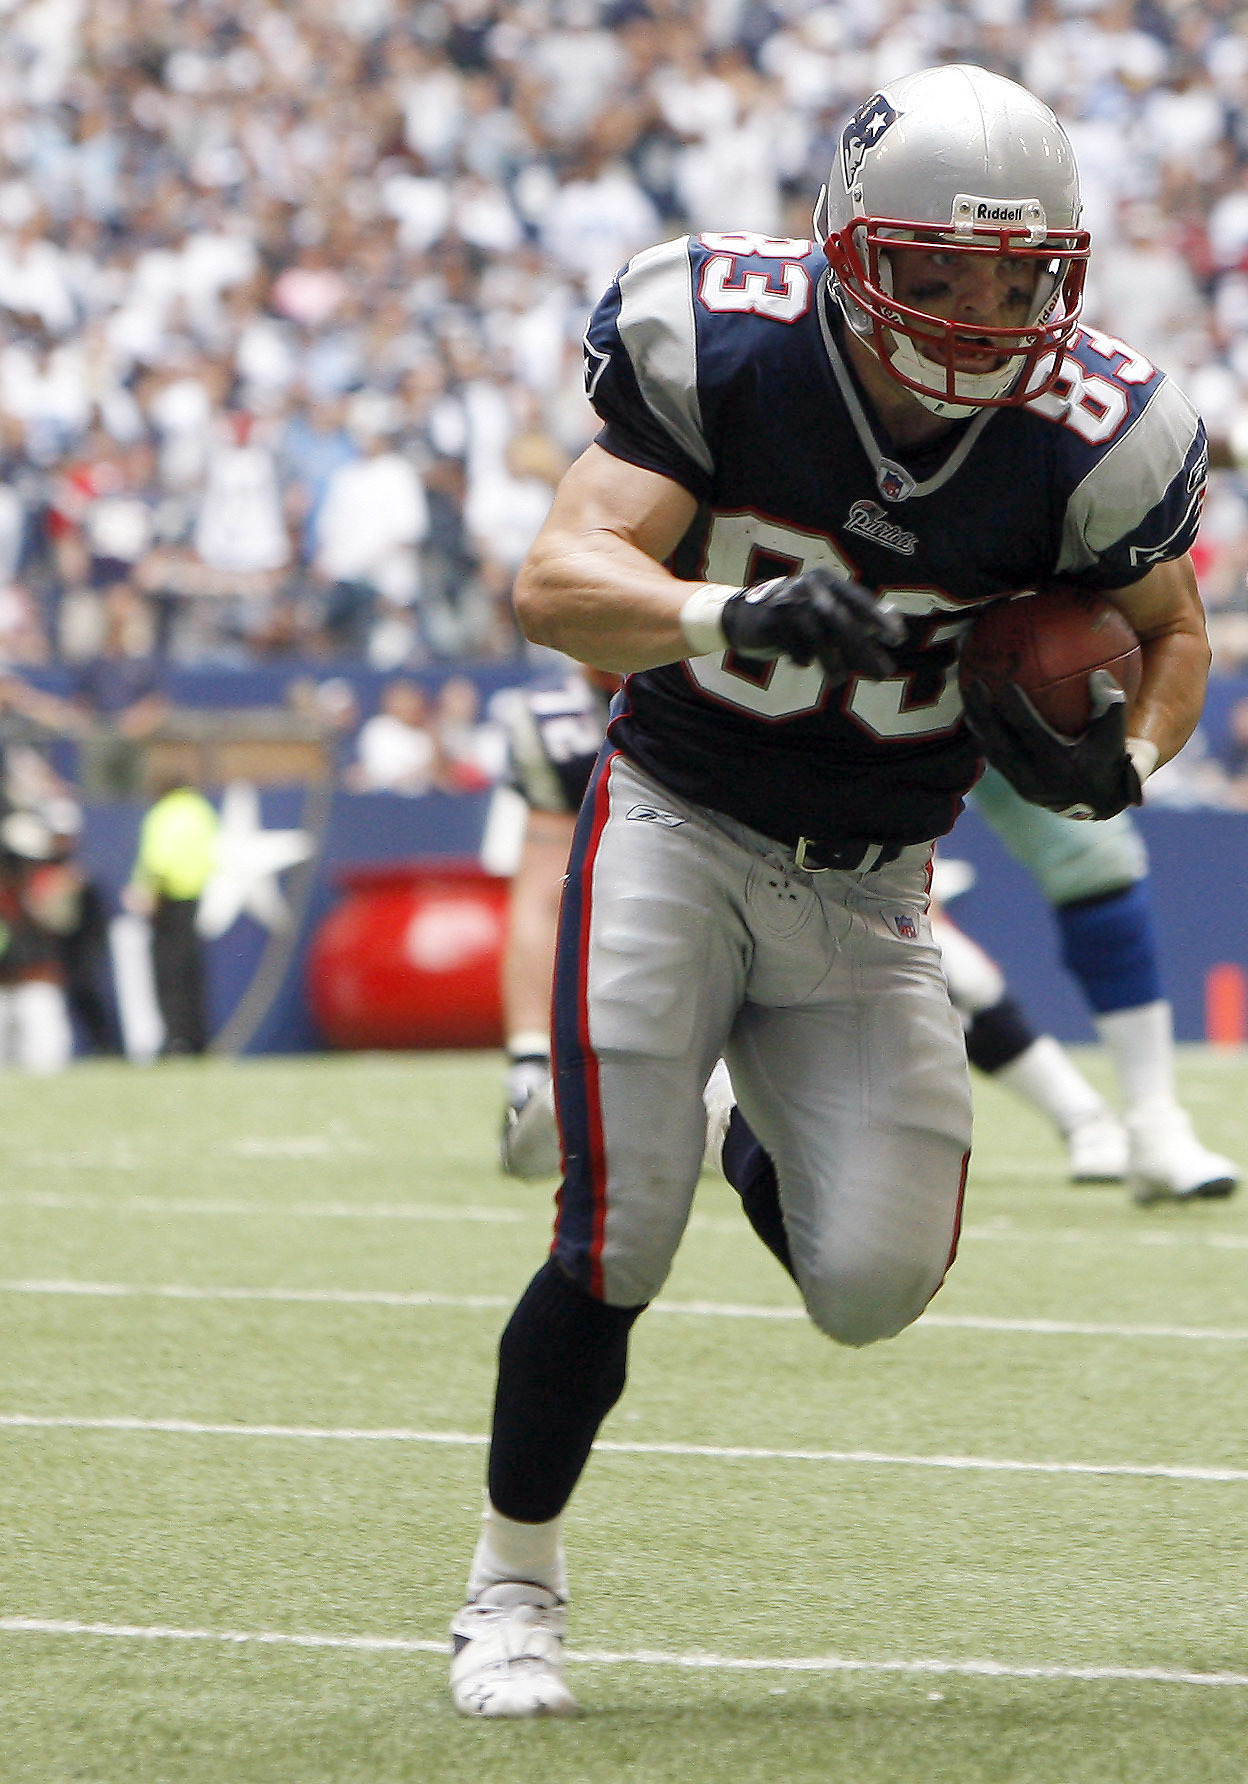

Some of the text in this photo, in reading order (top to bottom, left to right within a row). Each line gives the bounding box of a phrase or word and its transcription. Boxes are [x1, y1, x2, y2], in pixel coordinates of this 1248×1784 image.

[977, 203, 1022, 220] Riddell
[697, 230, 813, 324] 83
[1022, 319, 1157, 446] 83
